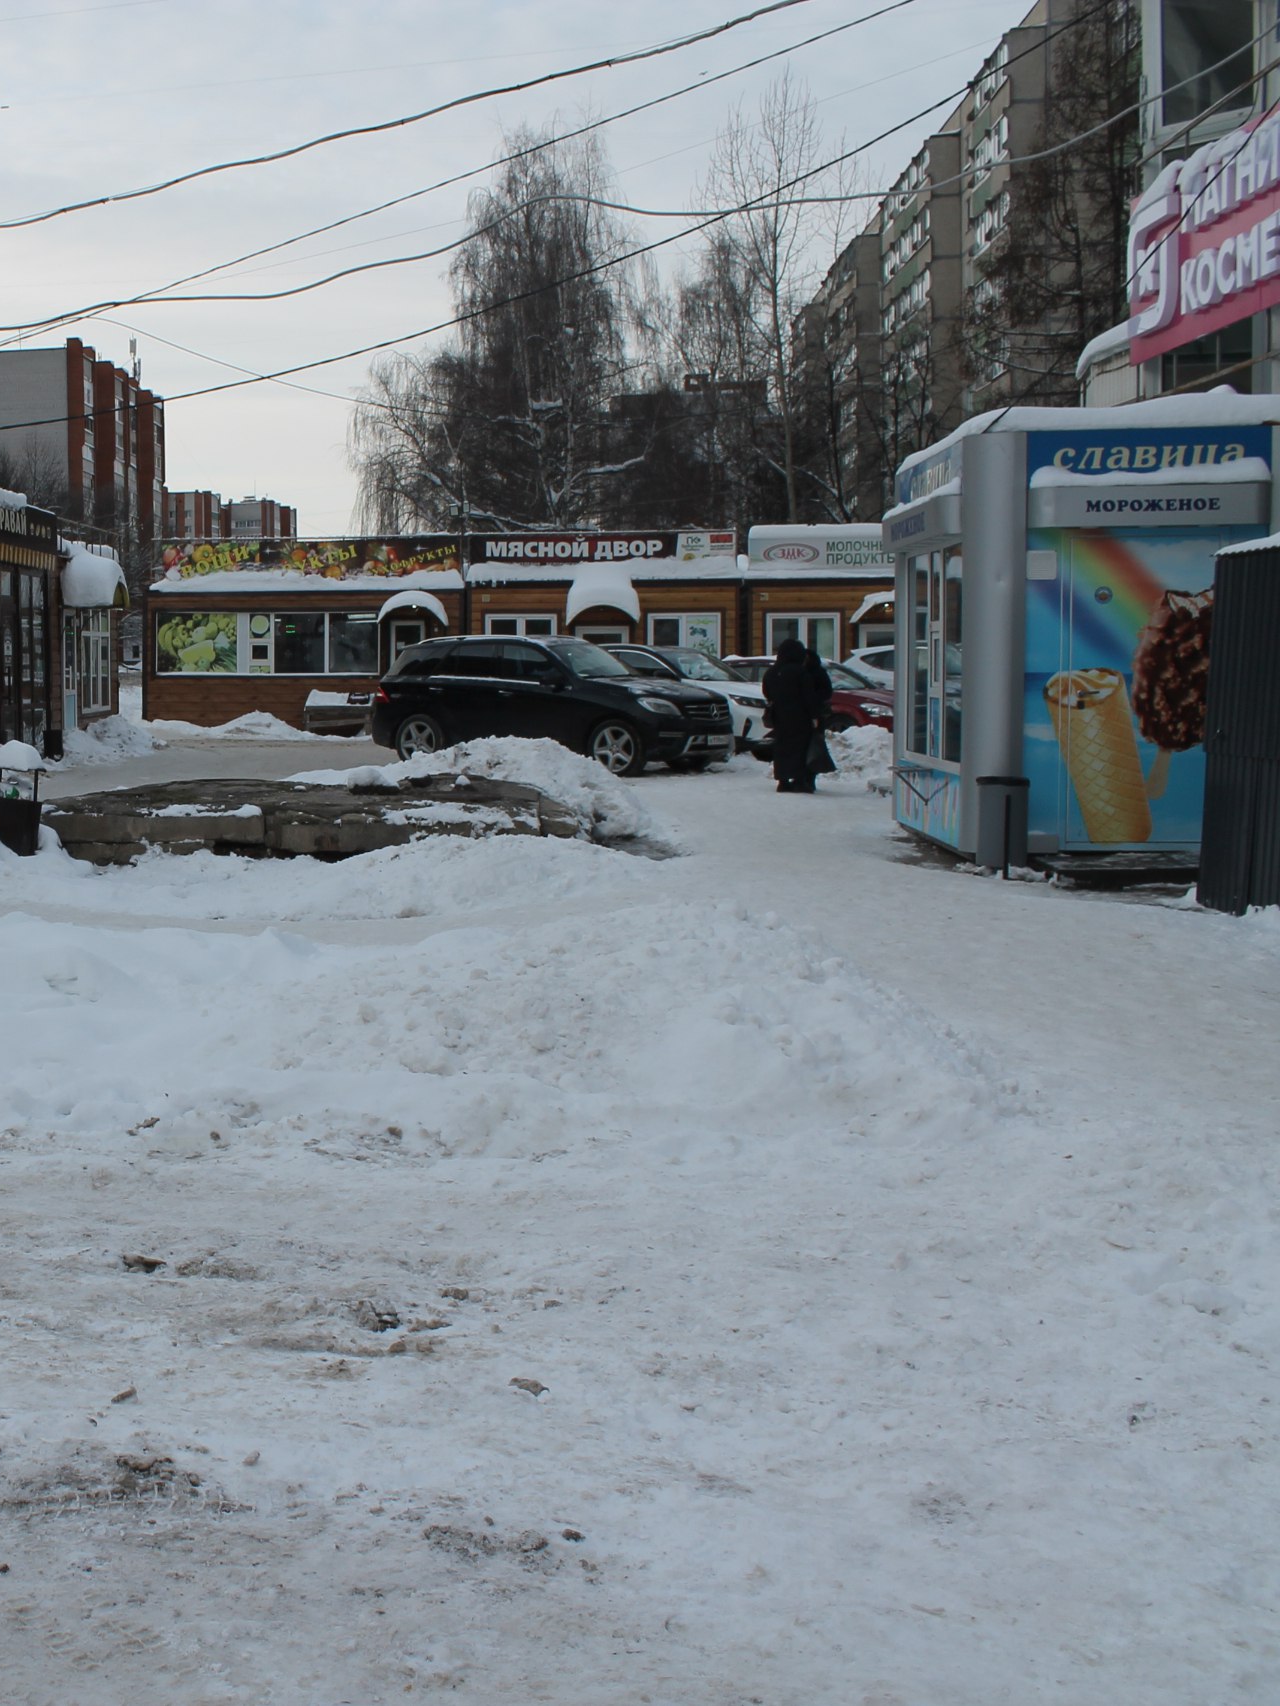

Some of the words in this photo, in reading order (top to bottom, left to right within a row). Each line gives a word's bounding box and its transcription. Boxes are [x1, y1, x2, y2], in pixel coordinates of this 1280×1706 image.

[1086, 497, 1221, 514] МОРОЖЕНОЕ
[282, 544, 358, 573] РУКТЫ
[368, 544, 458, 575] УХОФРУКТЫ
[485, 537, 589, 558] МЯСНОЙ
[594, 540, 663, 561] ДВОР
[826, 541, 882, 552] МОЛОЧН
[181, 545, 250, 579] ВОЩИ
